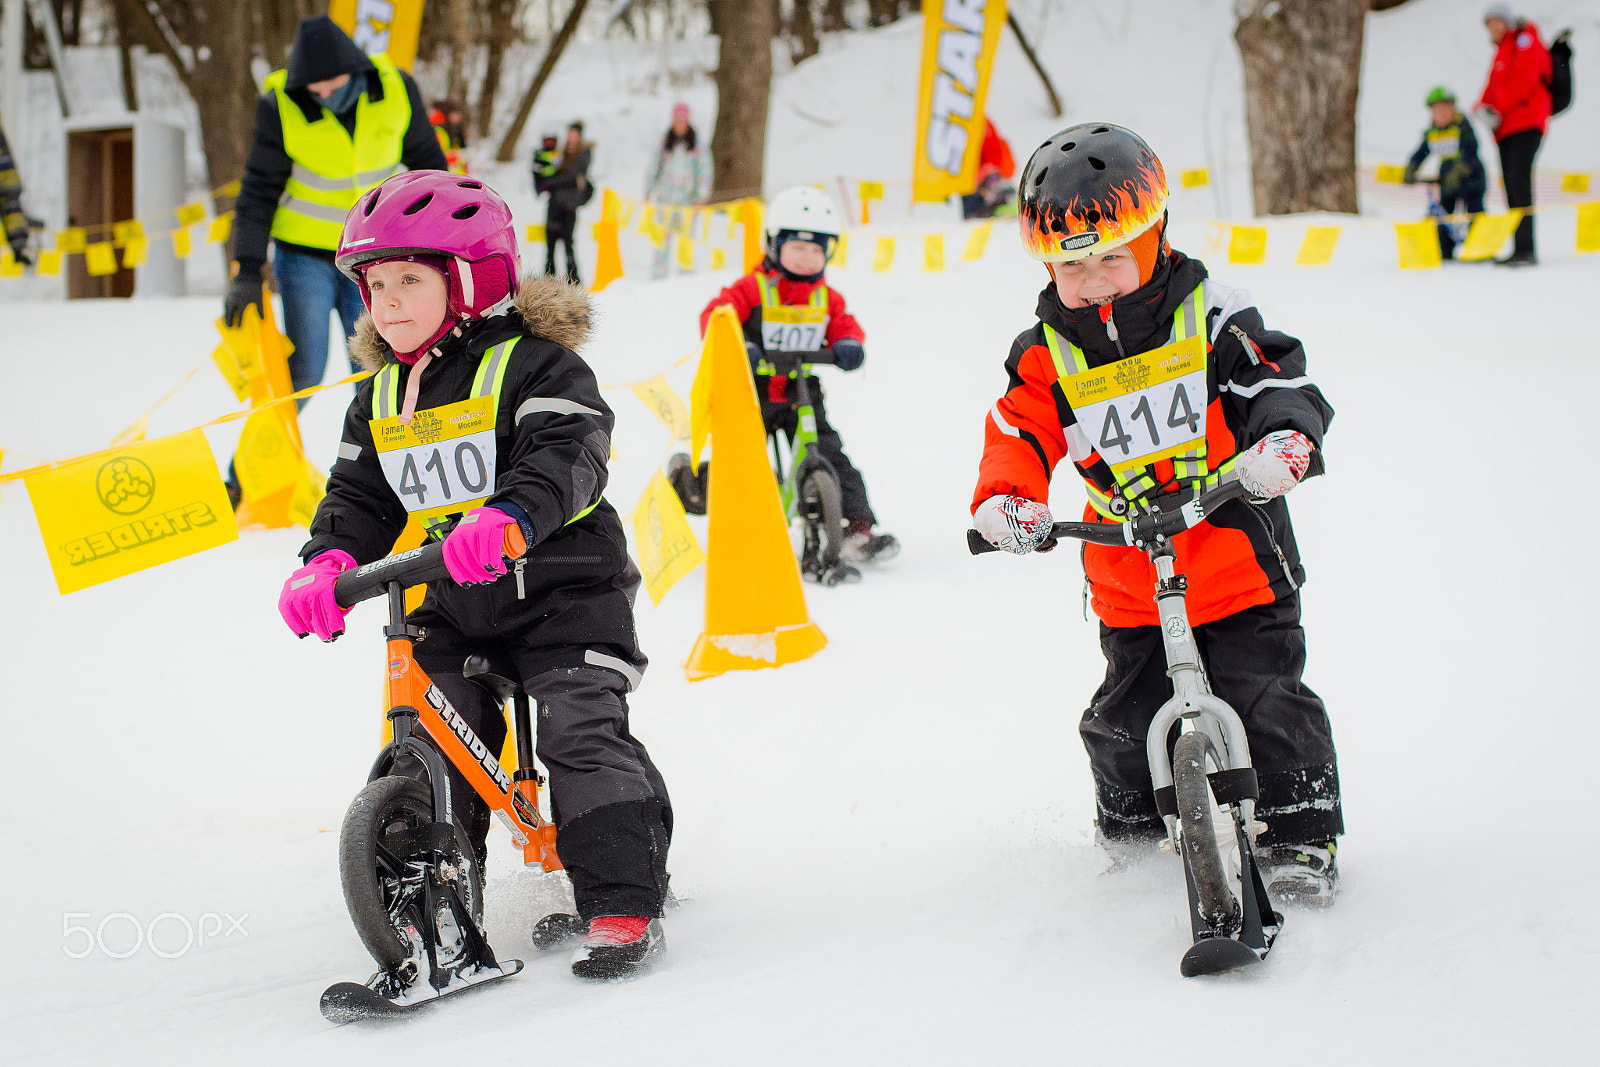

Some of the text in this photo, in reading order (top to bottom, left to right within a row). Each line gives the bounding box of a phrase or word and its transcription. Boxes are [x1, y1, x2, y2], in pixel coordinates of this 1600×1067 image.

[926, 0, 986, 177] STAR
[769, 326, 817, 350] 407
[1166, 360, 1191, 373] Москва
[457, 418, 482, 430] Москва
[1099, 382, 1200, 455] 414
[399, 441, 488, 504] 410
[356, 545, 424, 577] STRIDER
[424, 683, 512, 795] STRIDER
